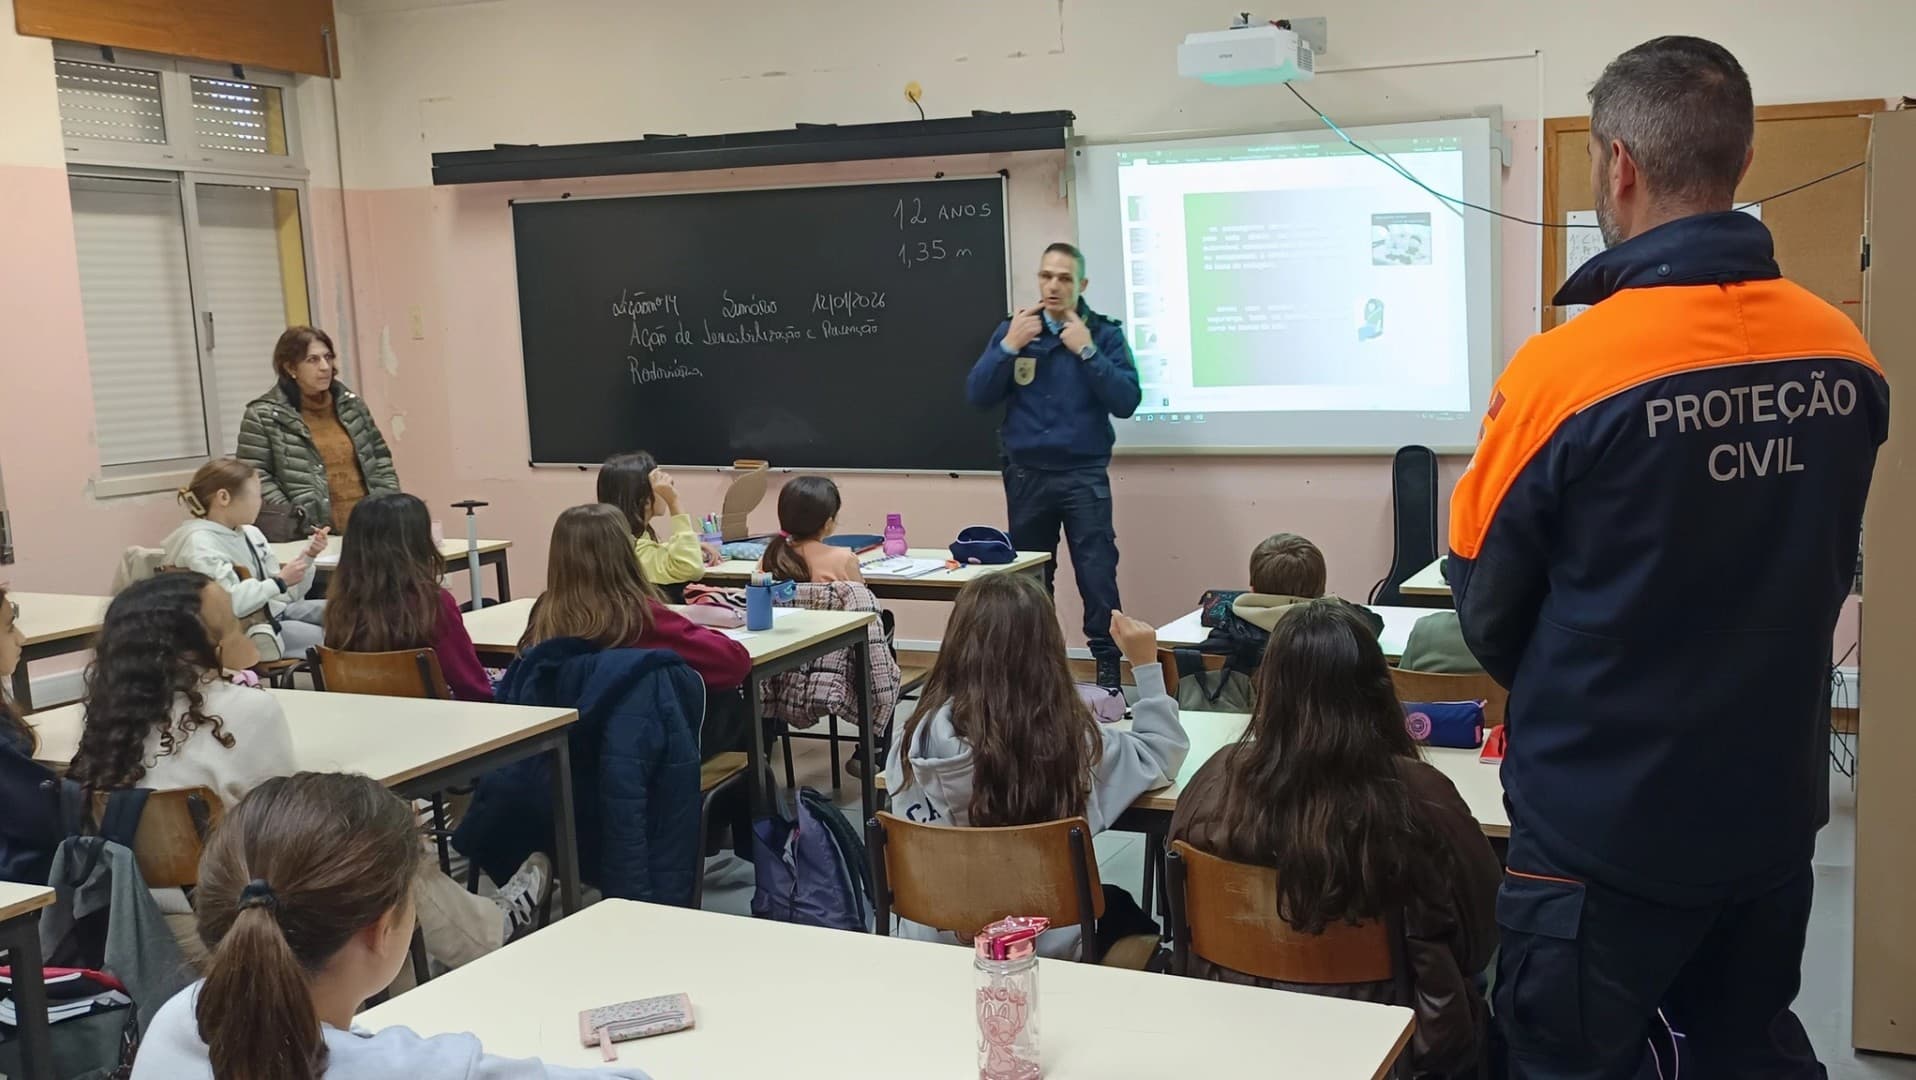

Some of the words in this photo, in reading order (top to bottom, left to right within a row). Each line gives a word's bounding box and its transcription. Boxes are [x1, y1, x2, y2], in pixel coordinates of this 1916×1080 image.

[893, 197, 928, 231] 12
[938, 202, 993, 221] ANOS
[898, 239, 947, 269] 1,35
[811, 290, 887, 317] 12/01/2026
[629, 319, 668, 352] Ação
[675, 319, 694, 345] de
[1646, 370, 1857, 438] PROTEÇÃO
[1707, 436, 1805, 482] CIVIL
